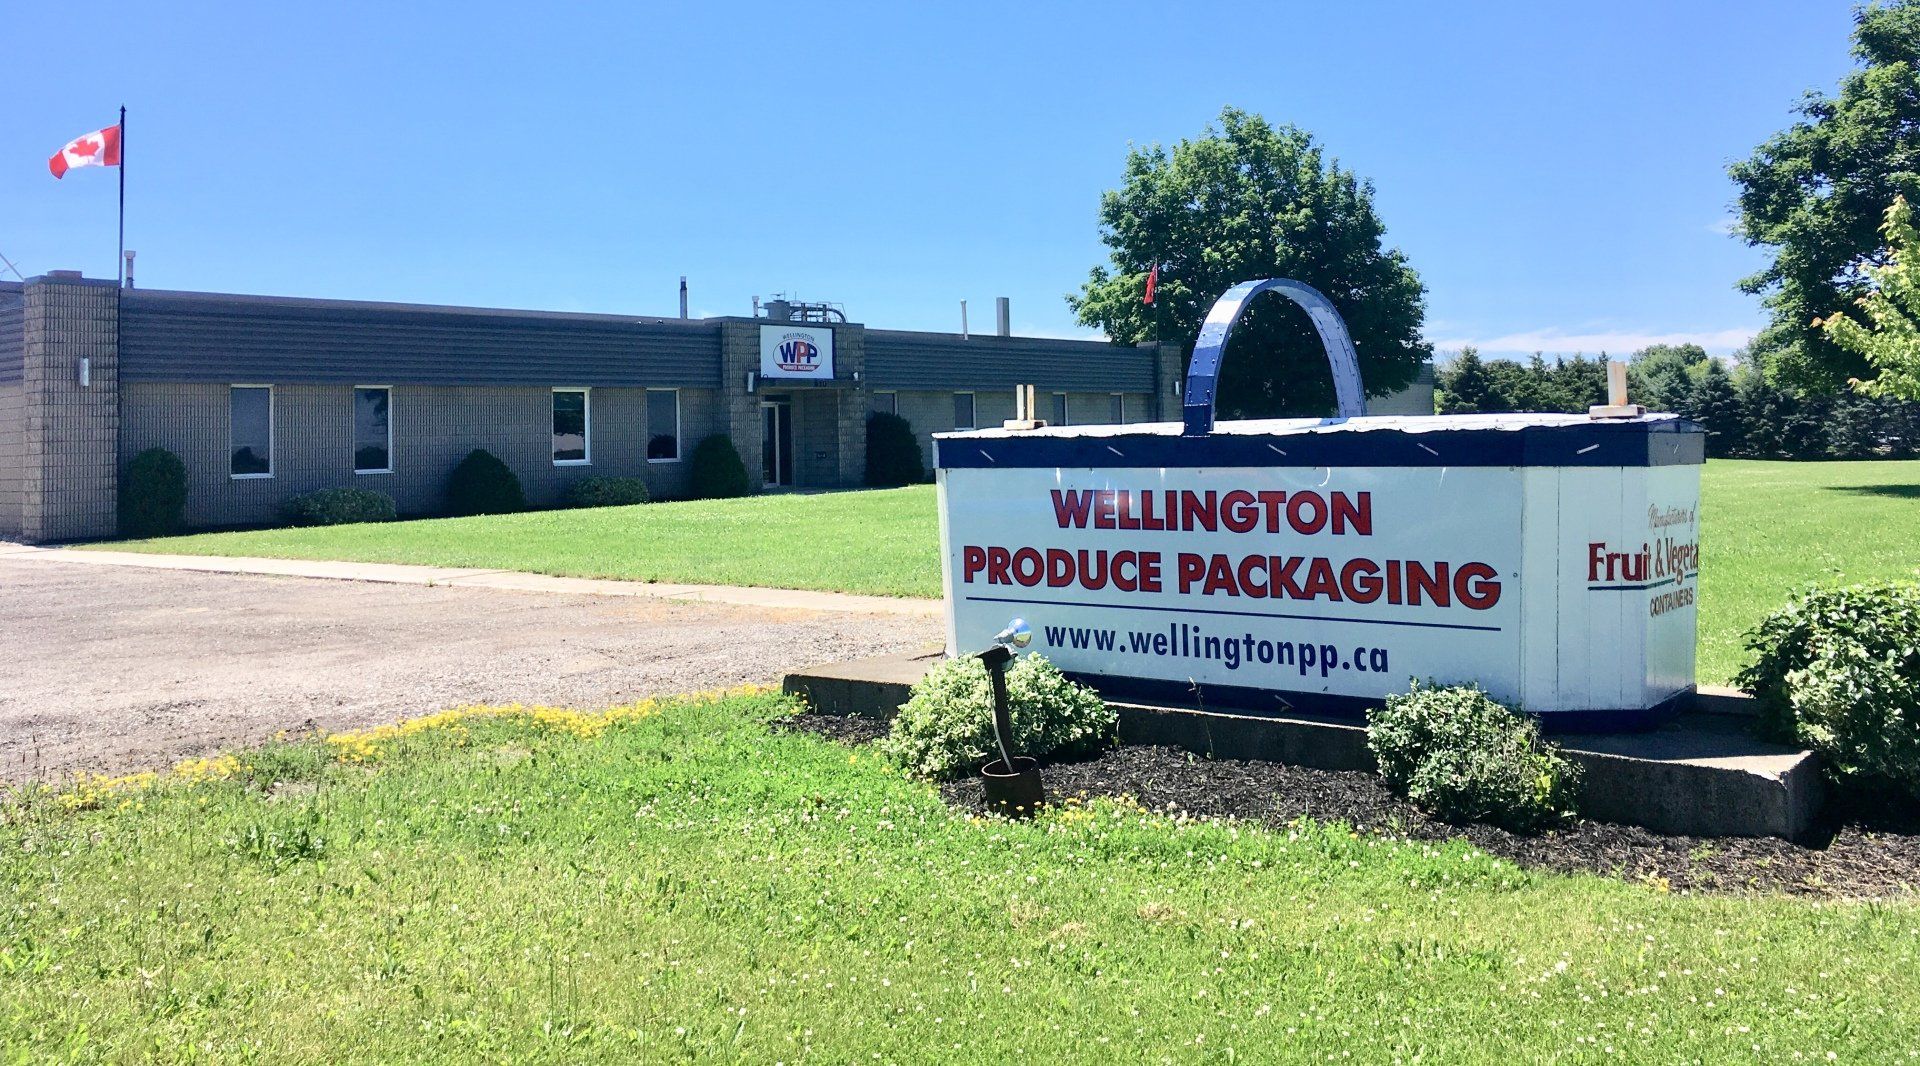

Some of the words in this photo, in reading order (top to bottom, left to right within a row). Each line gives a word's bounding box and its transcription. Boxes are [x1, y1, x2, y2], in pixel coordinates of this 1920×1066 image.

[779, 342, 818, 363] WPP
[783, 332, 815, 342] WELLINGTON
[1050, 489, 1373, 536] WELLINGTON
[1688, 500, 1697, 532] of
[963, 545, 1163, 594] PRODUCE
[1177, 552, 1503, 611] PACKAGING
[1588, 542, 1651, 581] Fruit
[1655, 538, 1665, 578] &
[1650, 587, 1694, 618] CONTAINERS
[1044, 623, 1390, 678] www.wellingtonpp.ca
